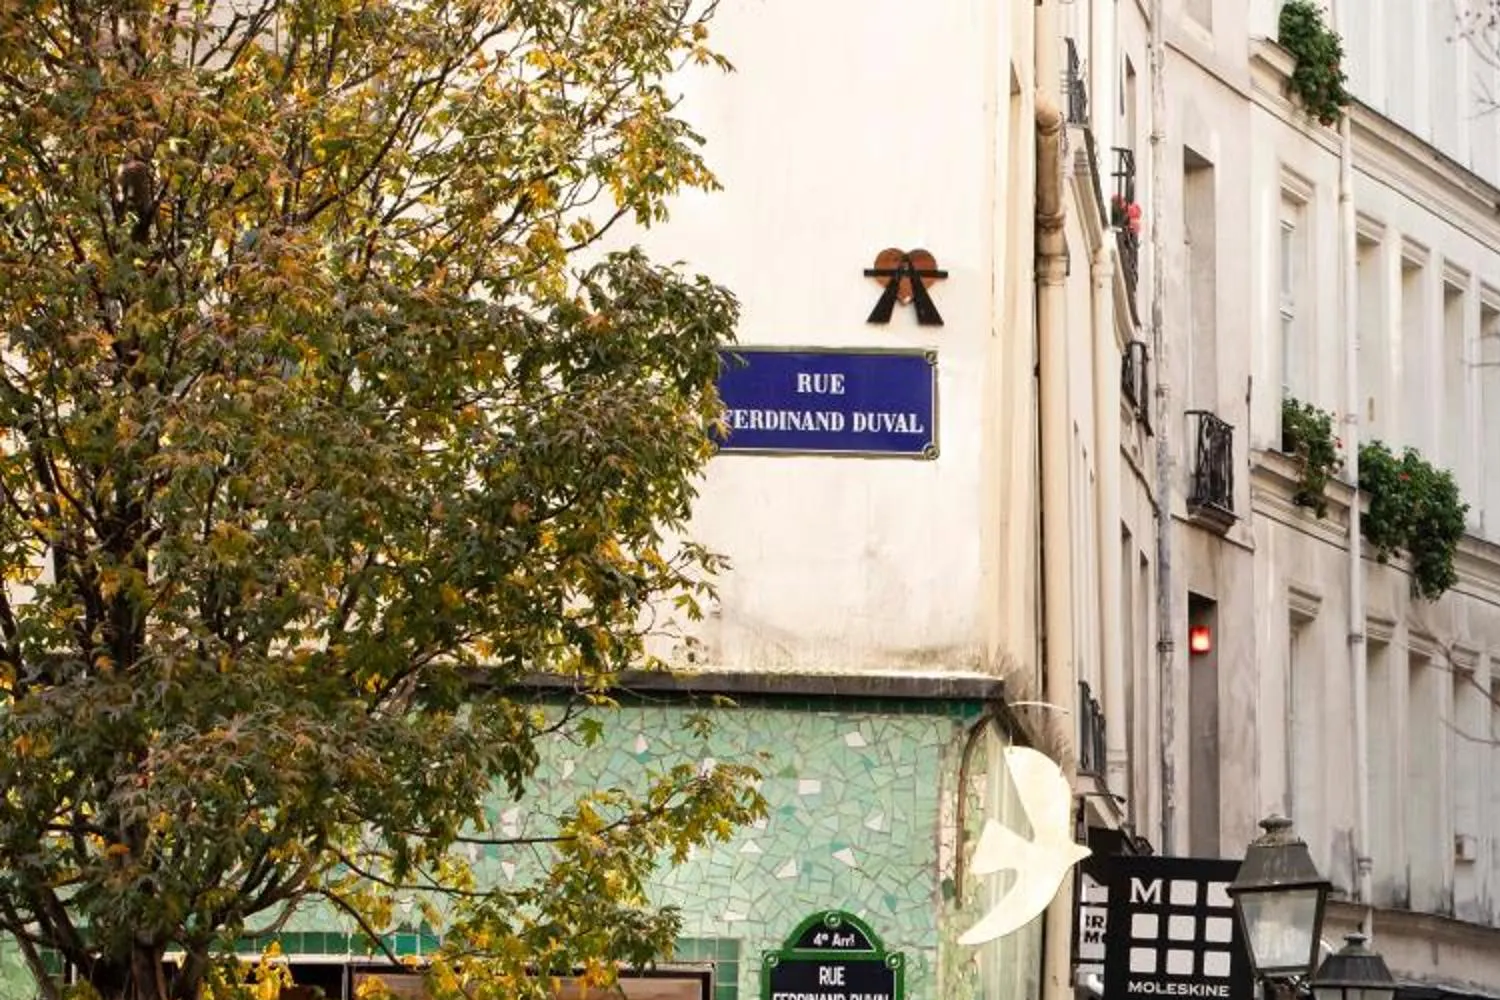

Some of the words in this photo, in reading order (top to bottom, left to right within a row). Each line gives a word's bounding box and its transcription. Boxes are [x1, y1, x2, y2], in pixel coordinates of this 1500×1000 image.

[797, 373, 845, 394] RUE
[853, 413, 924, 433] DUVAL
[1129, 877, 1163, 905] M
[819, 966, 845, 986] RUE
[1127, 981, 1231, 997] MOLESKINE
